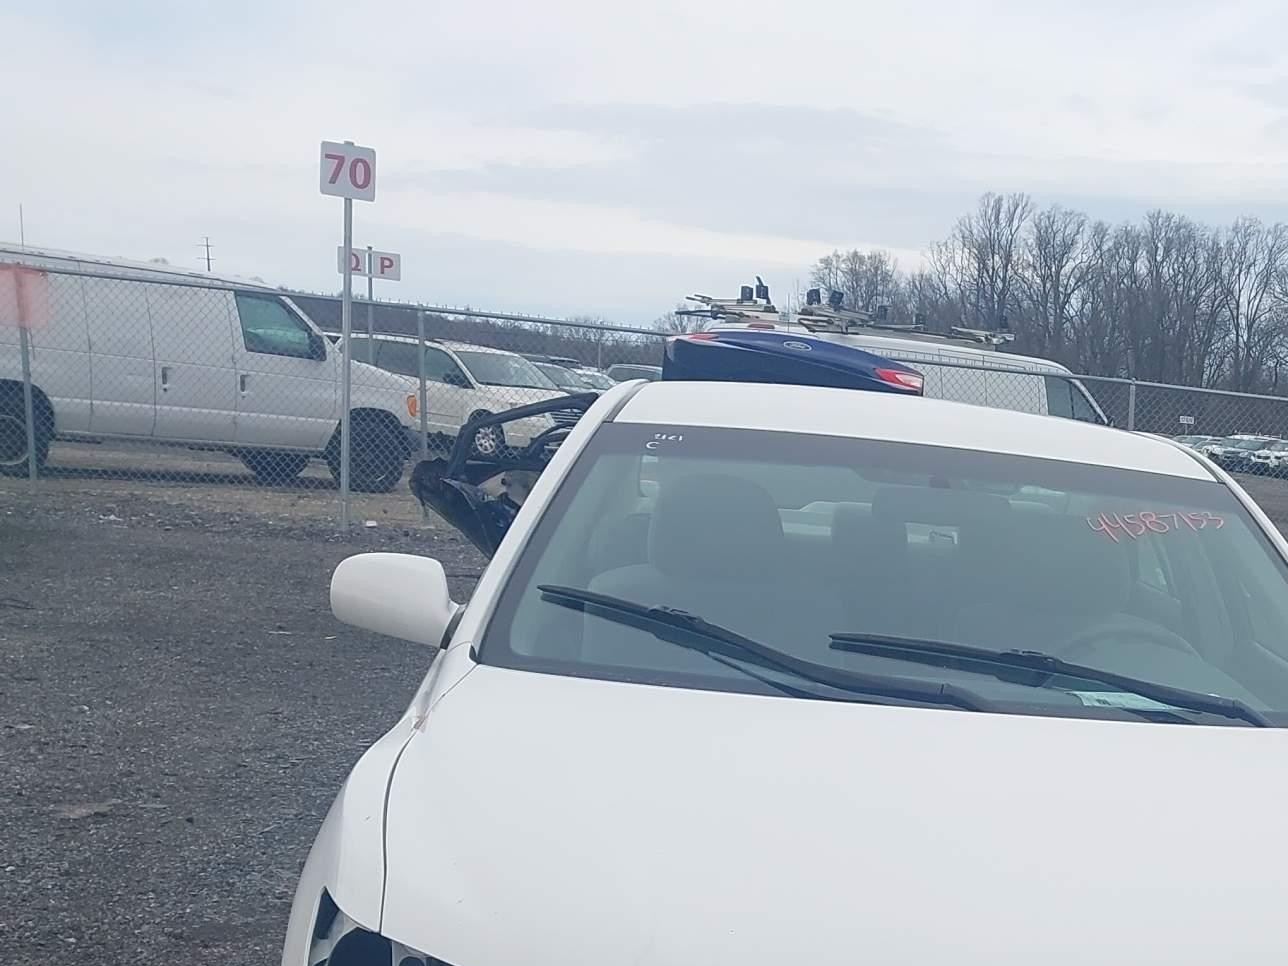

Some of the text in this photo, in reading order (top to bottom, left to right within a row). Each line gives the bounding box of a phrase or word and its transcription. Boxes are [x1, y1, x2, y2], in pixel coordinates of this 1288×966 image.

[324, 153, 371, 189] 70
[380, 256, 393, 274] P
[1086, 511, 1225, 543] 44587153
